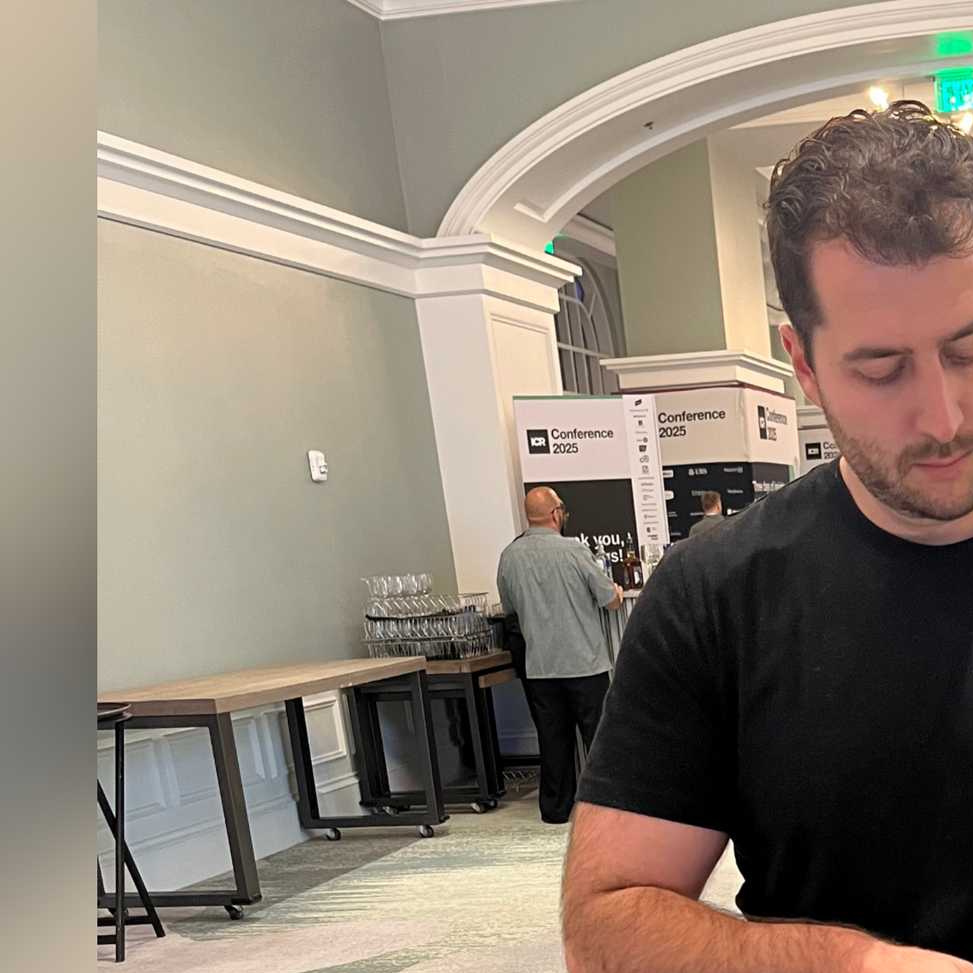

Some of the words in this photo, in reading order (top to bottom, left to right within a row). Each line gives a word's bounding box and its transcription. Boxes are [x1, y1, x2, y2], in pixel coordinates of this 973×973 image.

[658, 410, 726, 424] Conference
[551, 428, 614, 440] Conference
[659, 426, 687, 438] 2025
[553, 443, 579, 454] 2025
